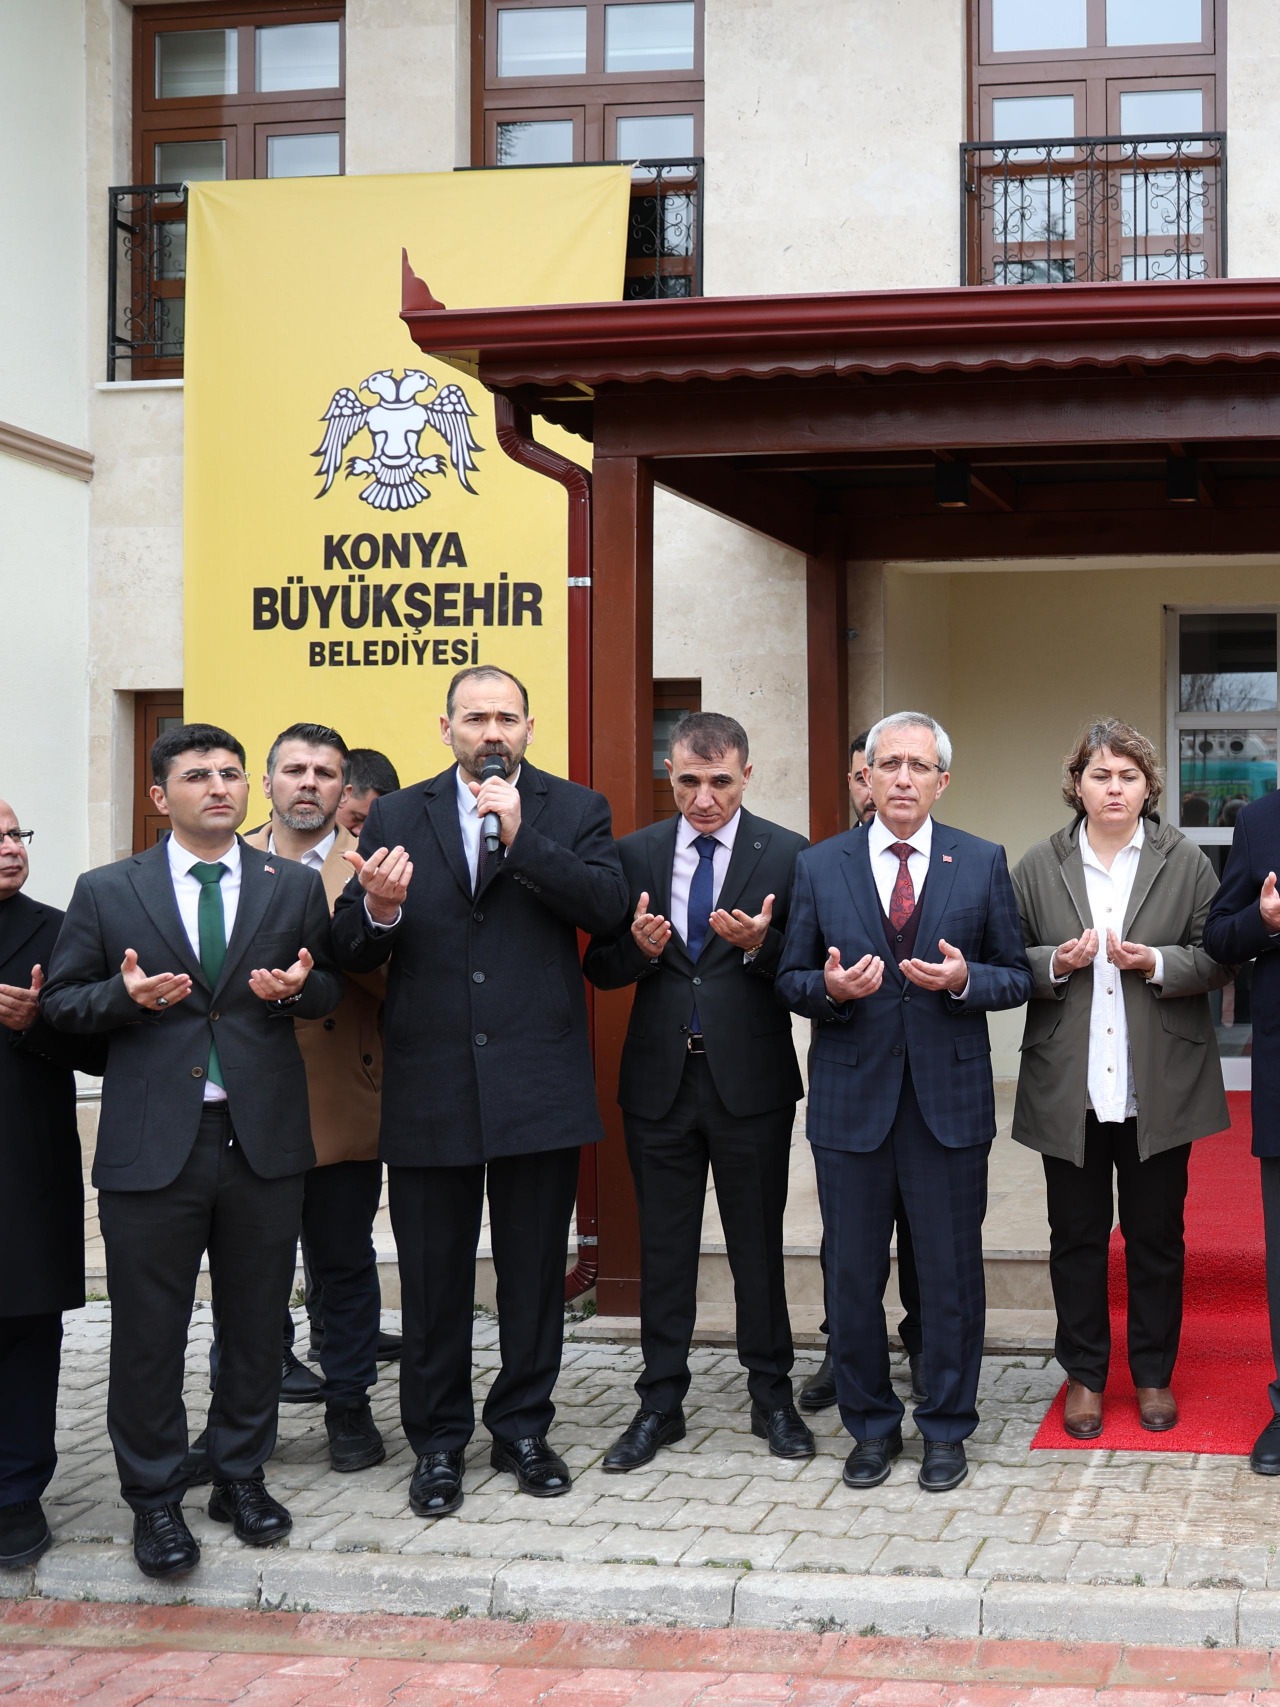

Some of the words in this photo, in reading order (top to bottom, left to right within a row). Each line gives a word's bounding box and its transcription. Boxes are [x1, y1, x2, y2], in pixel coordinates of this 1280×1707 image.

[323, 531, 468, 571] KONYA
[252, 571, 543, 635] BÜYÜKŞEHİR
[309, 632, 479, 667] BELEDİYESİ
